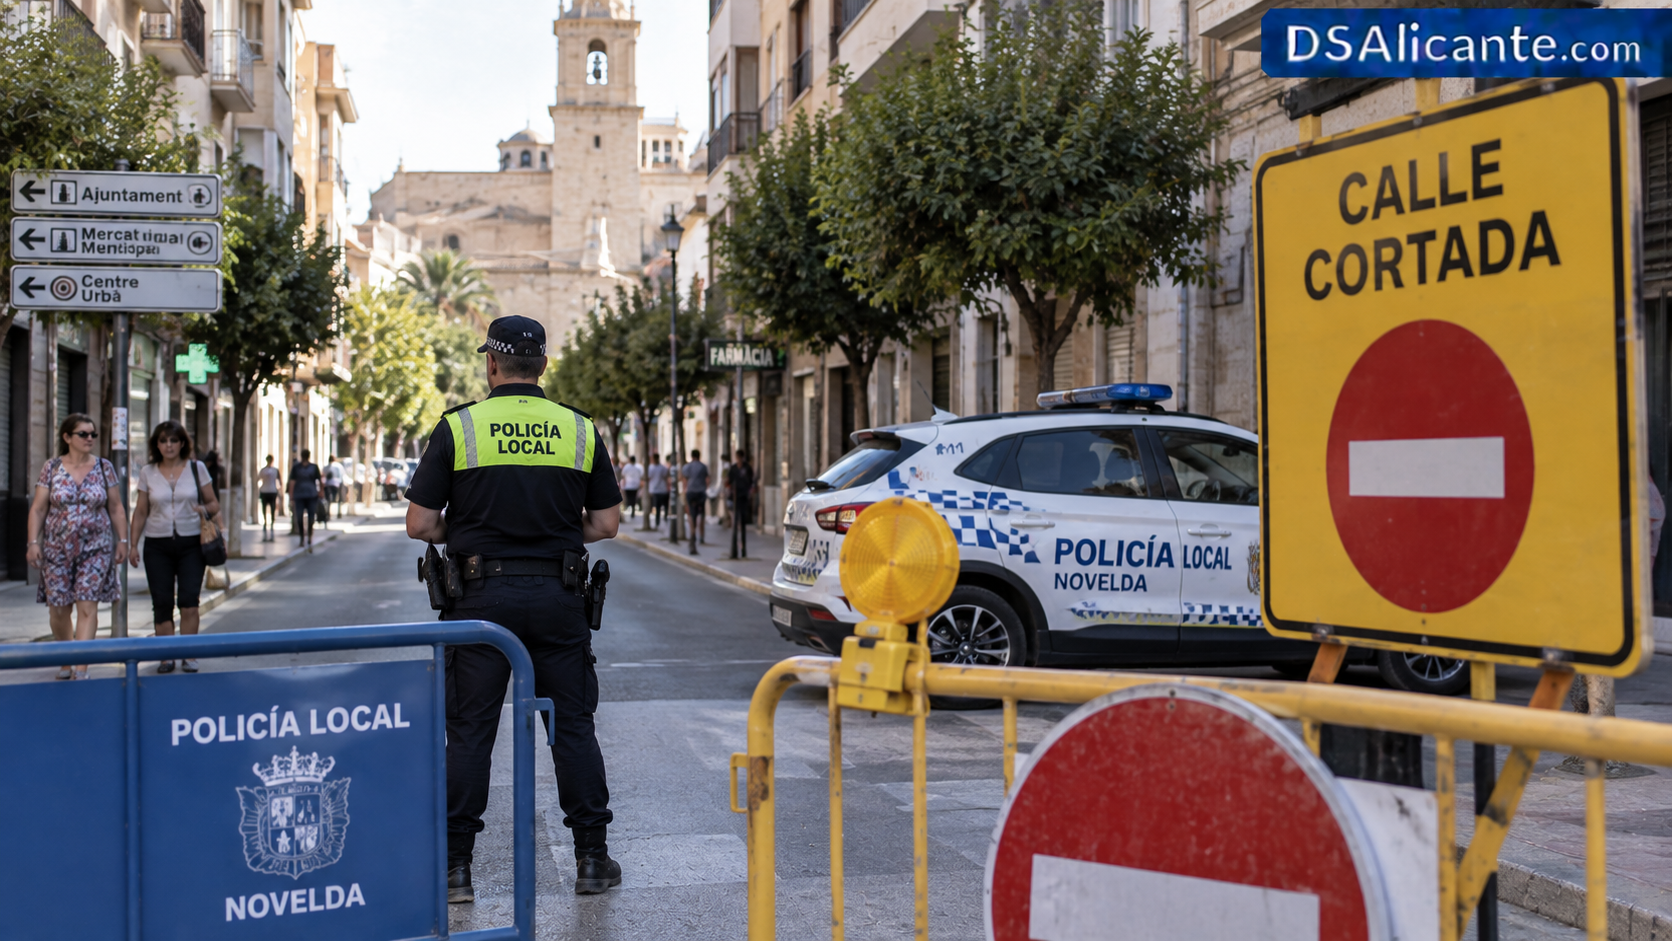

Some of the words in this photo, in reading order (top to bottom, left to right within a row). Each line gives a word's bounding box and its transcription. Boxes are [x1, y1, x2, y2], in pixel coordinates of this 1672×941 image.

[1338, 138, 1504, 226] CALLE
[81, 187, 183, 205] Ajuntament
[81, 227, 140, 241] Mercat
[1304, 210, 1561, 301] CORTADA
[81, 274, 139, 288] Centre
[490, 420, 562, 440] POLICÍA
[497, 440, 556, 455] LOCAL
[1054, 535, 1175, 568] POLICÍA
[1183, 545, 1232, 570] LOCAL
[1054, 572, 1148, 593] NOVELDA
[171, 705, 301, 746] POLICÍA
[310, 702, 410, 735] LOCAL
[225, 883, 366, 922] NOVELDA
